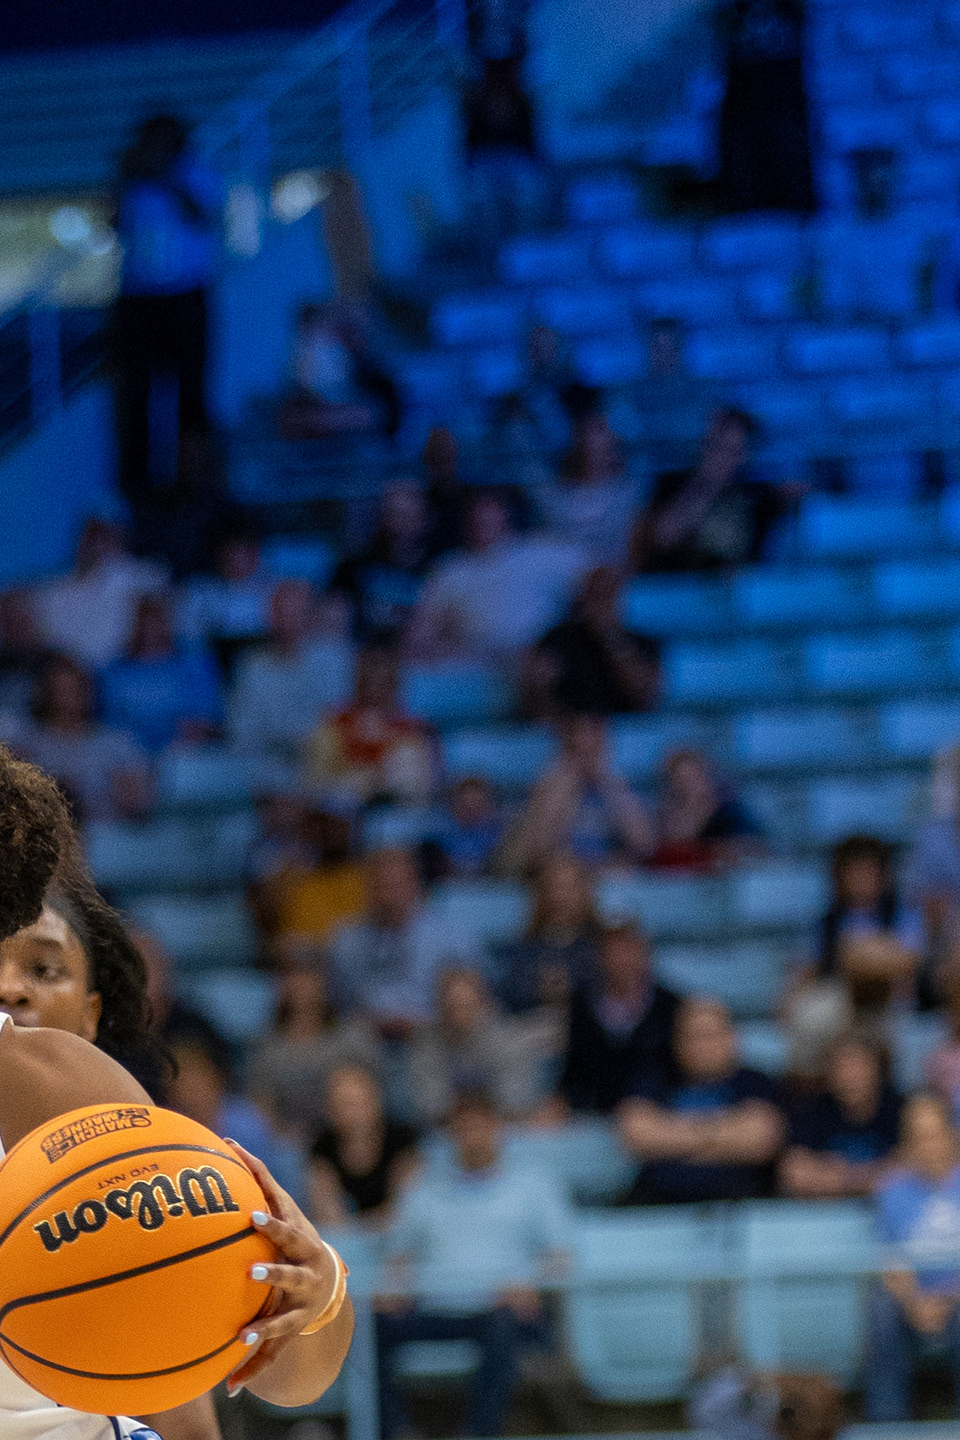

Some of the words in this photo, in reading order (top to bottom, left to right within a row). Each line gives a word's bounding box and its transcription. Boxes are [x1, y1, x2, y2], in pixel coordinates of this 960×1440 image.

[129, 1163, 159, 1178] EVO
[97, 1173, 127, 1190] NXT
[33, 1165, 240, 1253] Wilson
